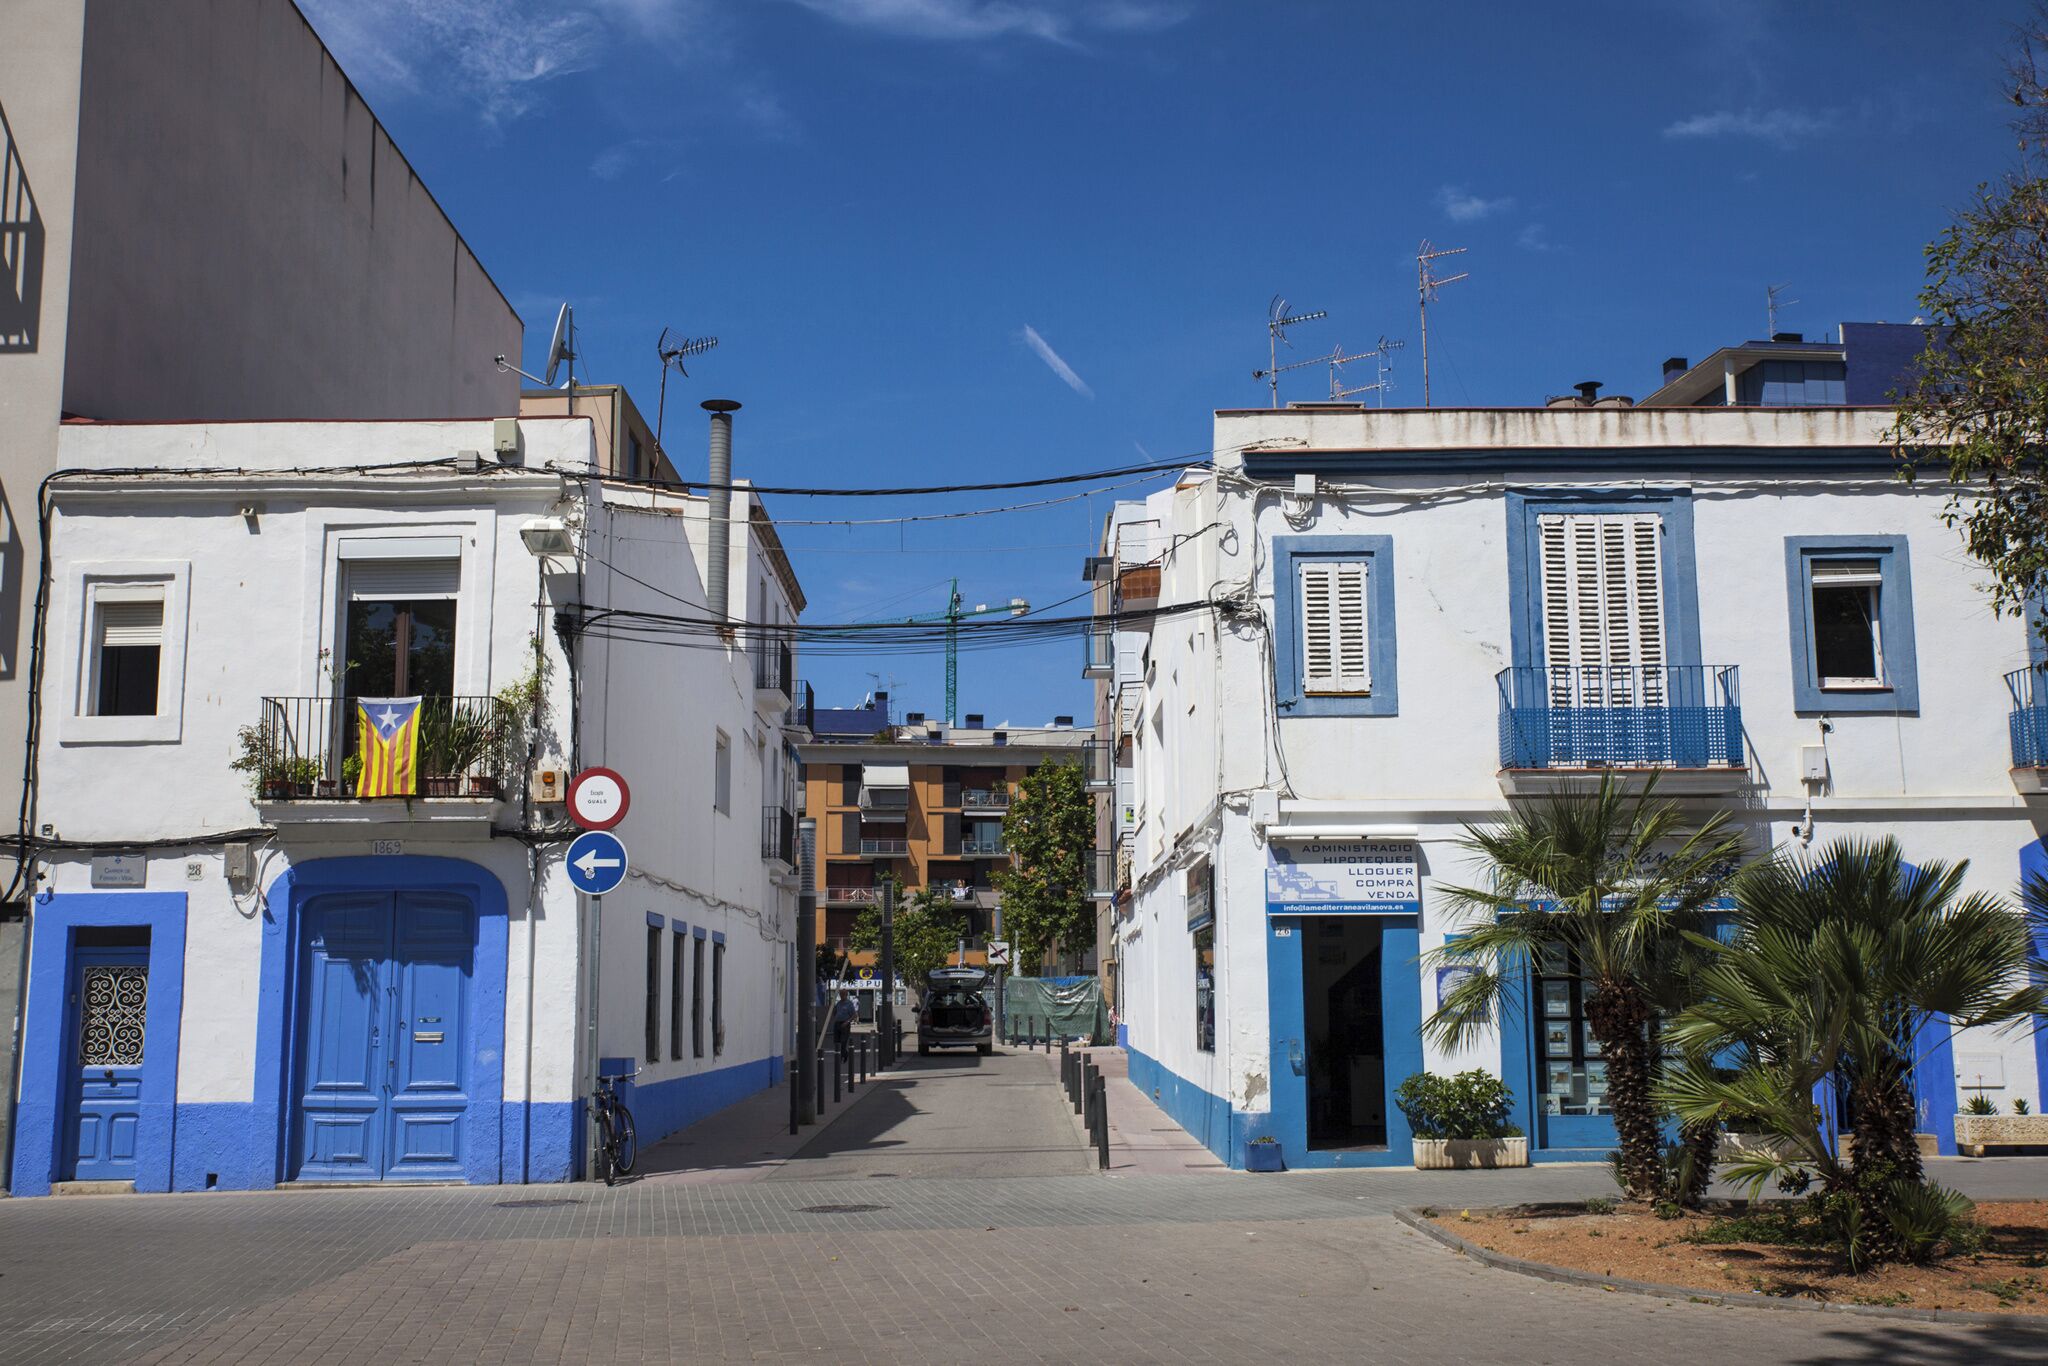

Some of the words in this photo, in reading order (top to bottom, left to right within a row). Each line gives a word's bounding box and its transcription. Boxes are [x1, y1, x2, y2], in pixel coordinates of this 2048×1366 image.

[374, 841, 401, 854] 1869
[1323, 856, 1413, 865] HIPOTEQUES
[188, 863, 201, 876] 28
[1348, 868, 1414, 876] LLOGUER
[1356, 879, 1415, 887] COMPRA
[1368, 891, 1415, 899] VENDA
[1283, 904, 1404, 912] info@lamediterraneavilanova.es
[1276, 927, 1290, 935] 26
